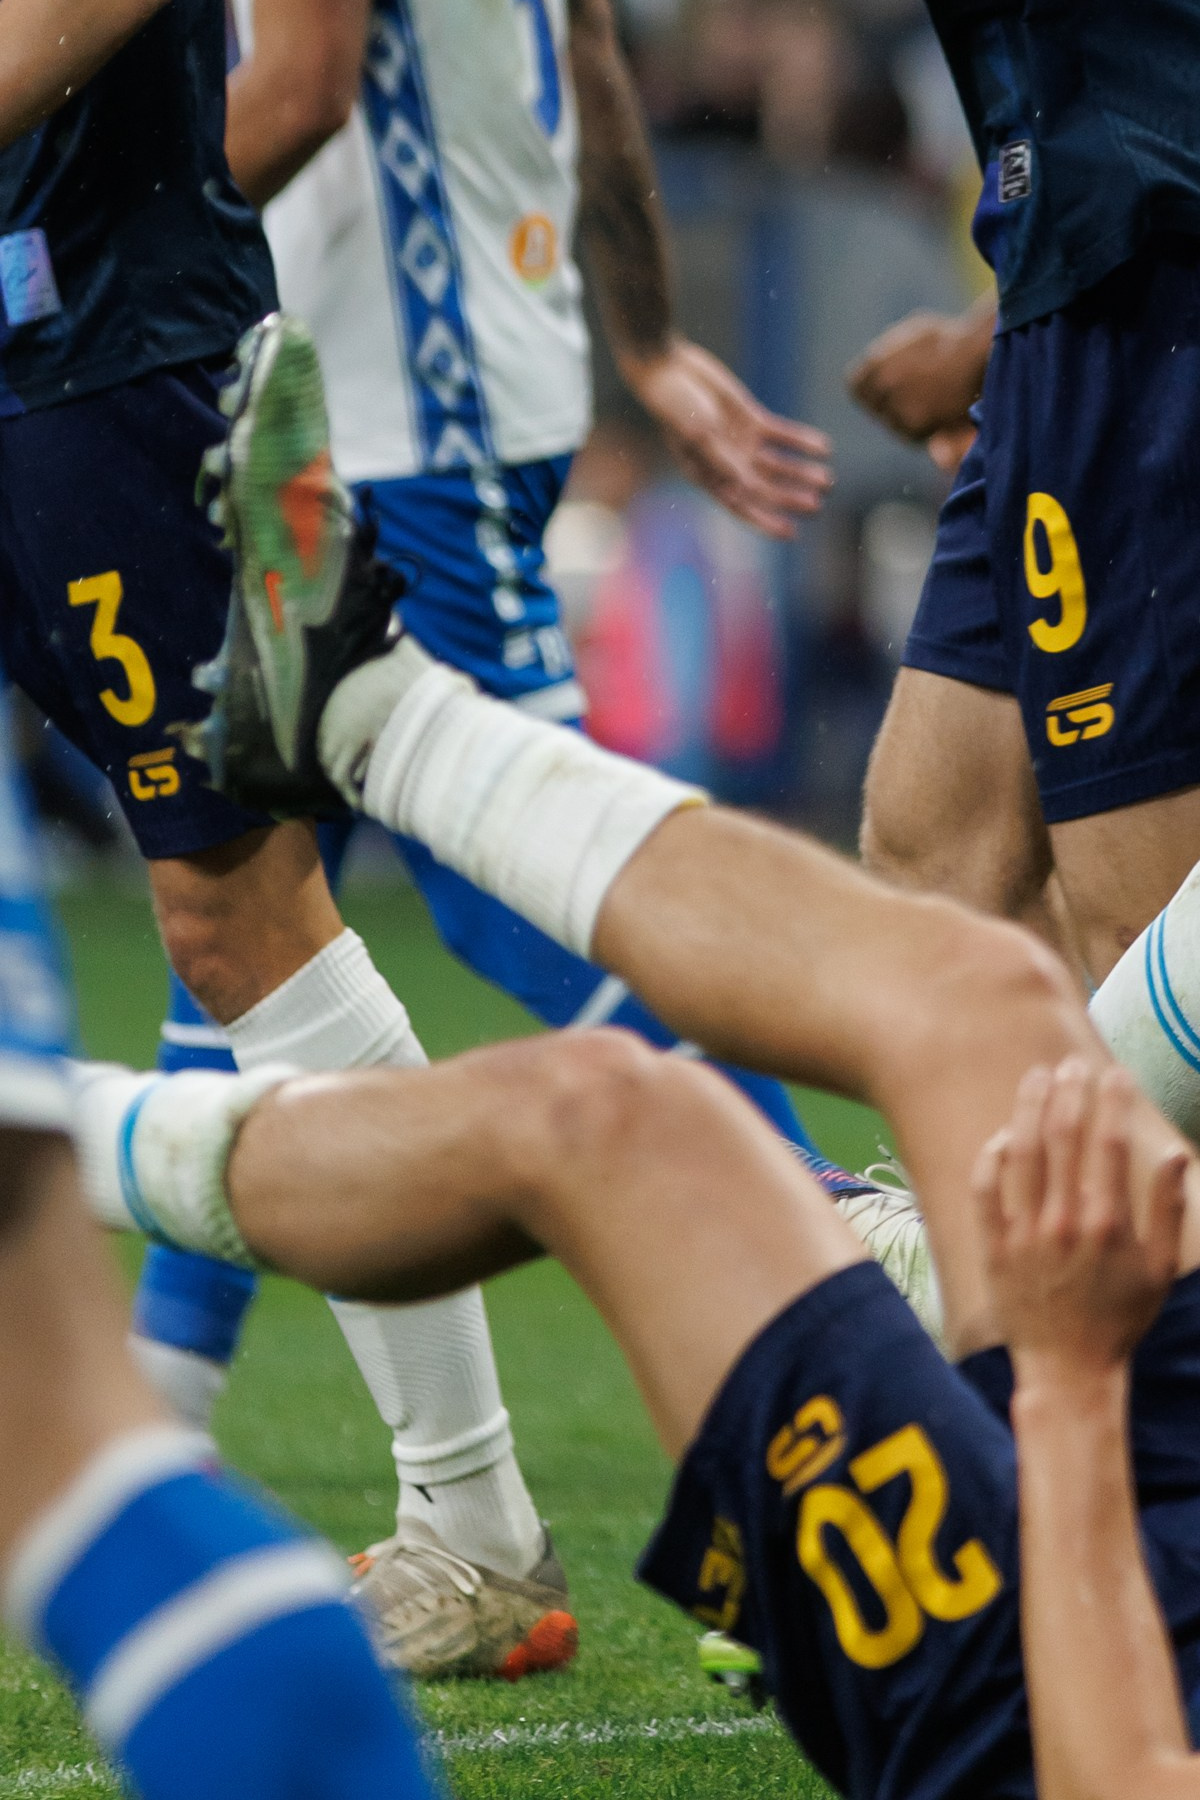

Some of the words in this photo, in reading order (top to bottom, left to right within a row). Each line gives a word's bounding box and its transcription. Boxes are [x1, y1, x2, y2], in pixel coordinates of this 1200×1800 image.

[66, 570, 157, 728] 3
[1023, 491, 1087, 654] 9
[797, 1424, 1002, 1670] 20
